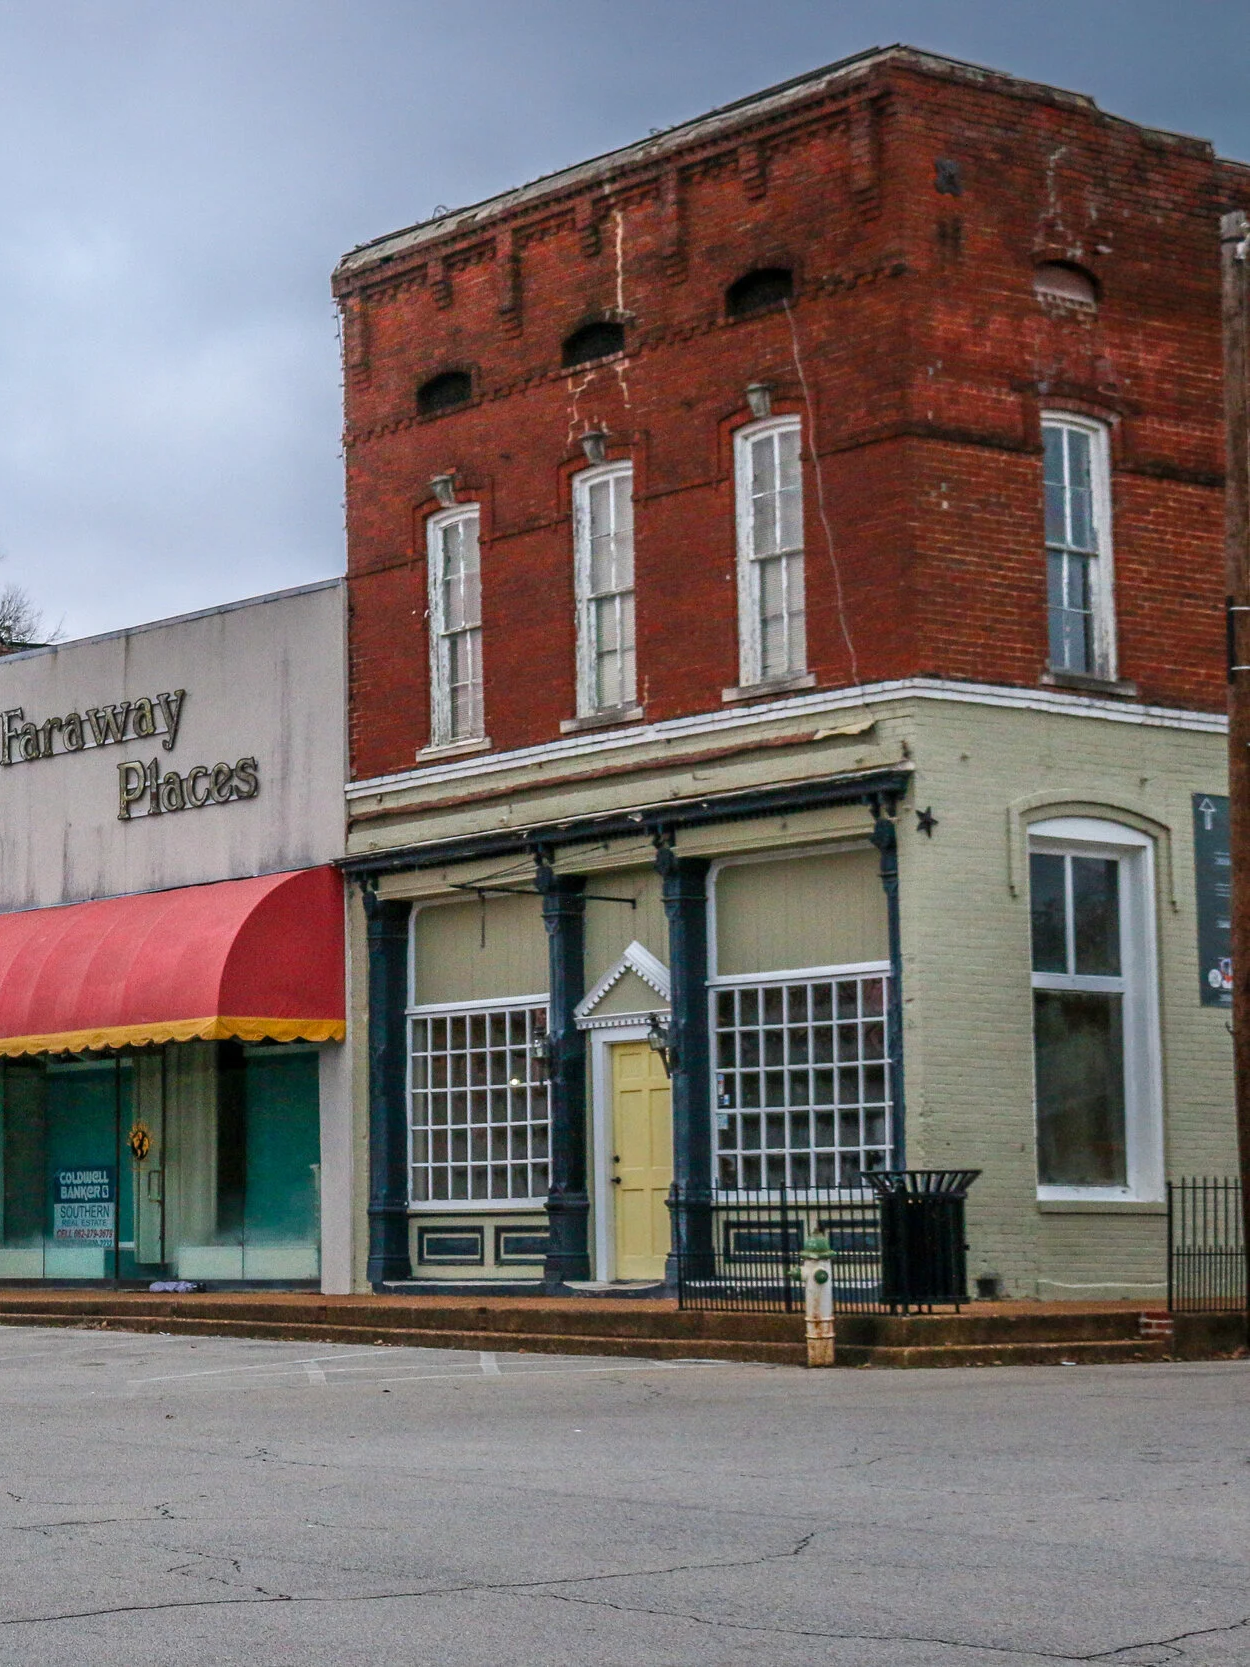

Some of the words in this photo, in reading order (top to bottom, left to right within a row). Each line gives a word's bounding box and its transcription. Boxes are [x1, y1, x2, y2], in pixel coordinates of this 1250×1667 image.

[0, 689, 186, 767] Faraway
[116, 756, 259, 820] Places
[60, 1205, 110, 1219] SOUTHERN
[61, 1219, 78, 1227] REAL
[81, 1219, 107, 1227] ESTATE
